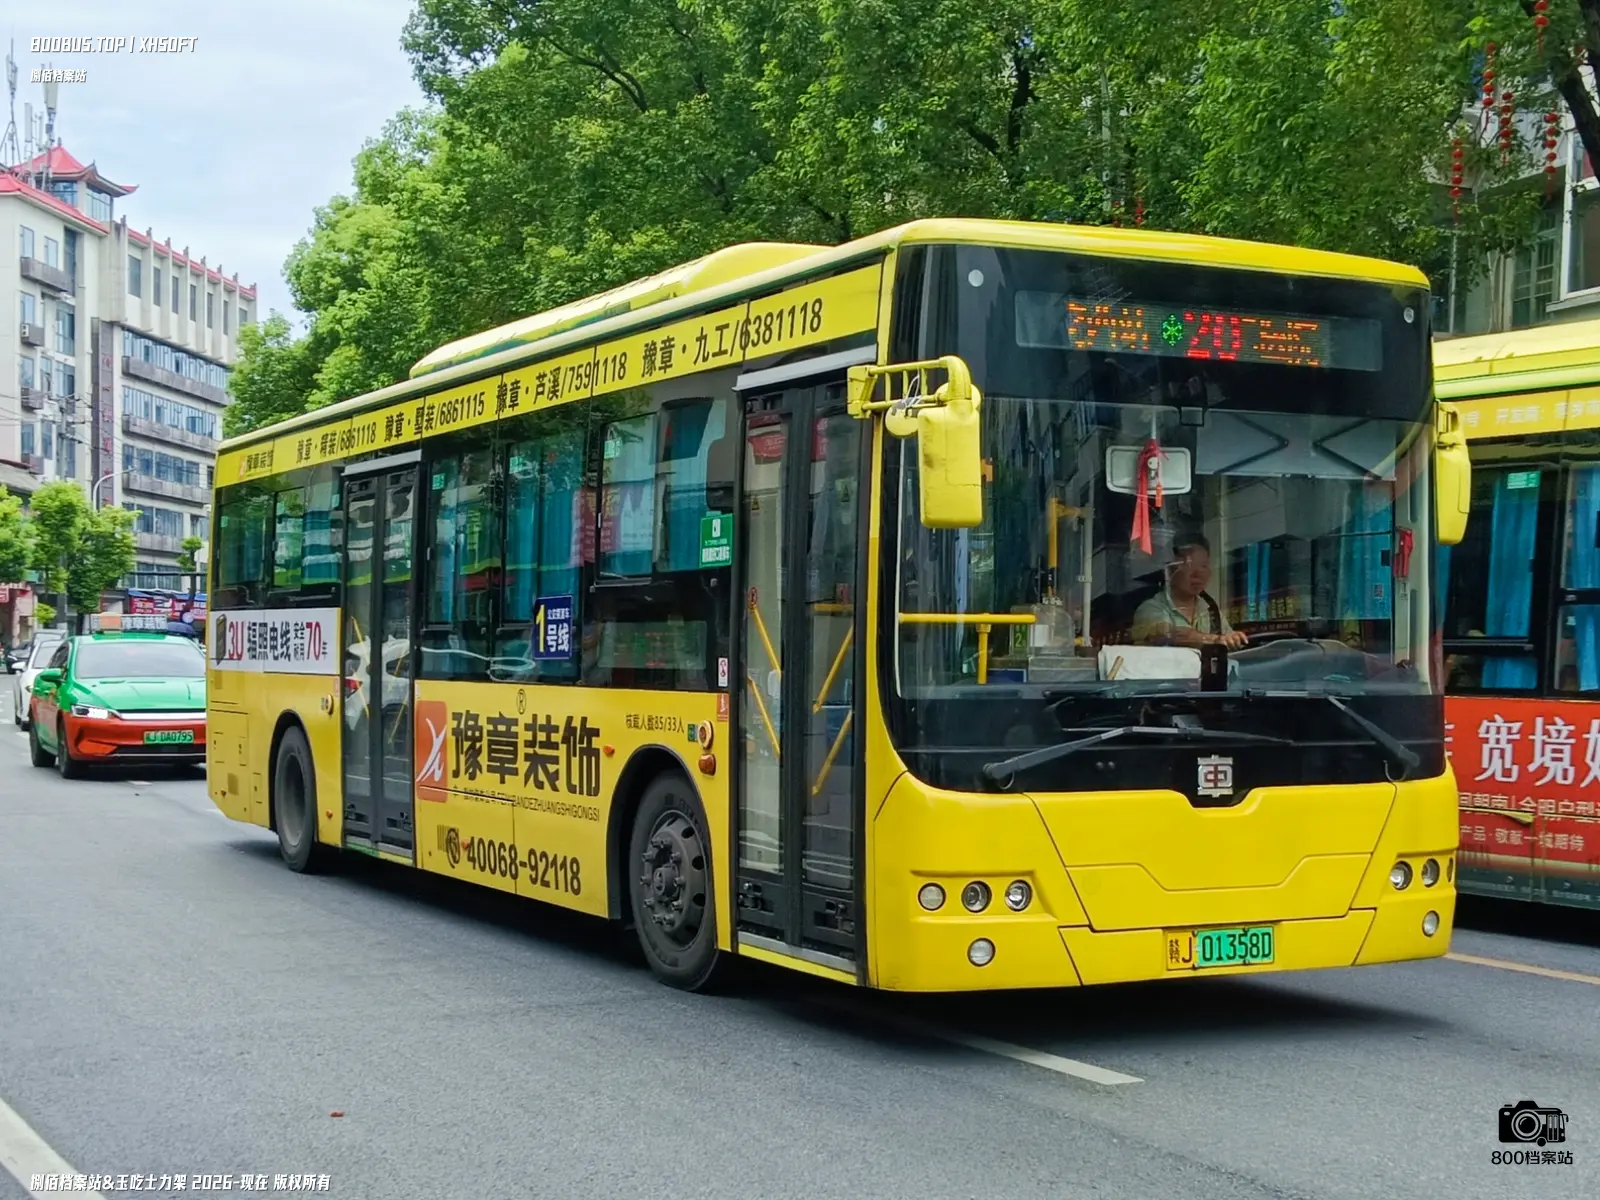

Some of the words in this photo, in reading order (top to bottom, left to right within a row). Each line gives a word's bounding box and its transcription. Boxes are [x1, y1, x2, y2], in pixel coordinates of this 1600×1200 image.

[1184, 310, 1242, 360] 20
[451, 710, 600, 797] 豫章装饰
[466, 834, 582, 896] 40068-92118
[1201, 931, 1273, 962] 01358D
